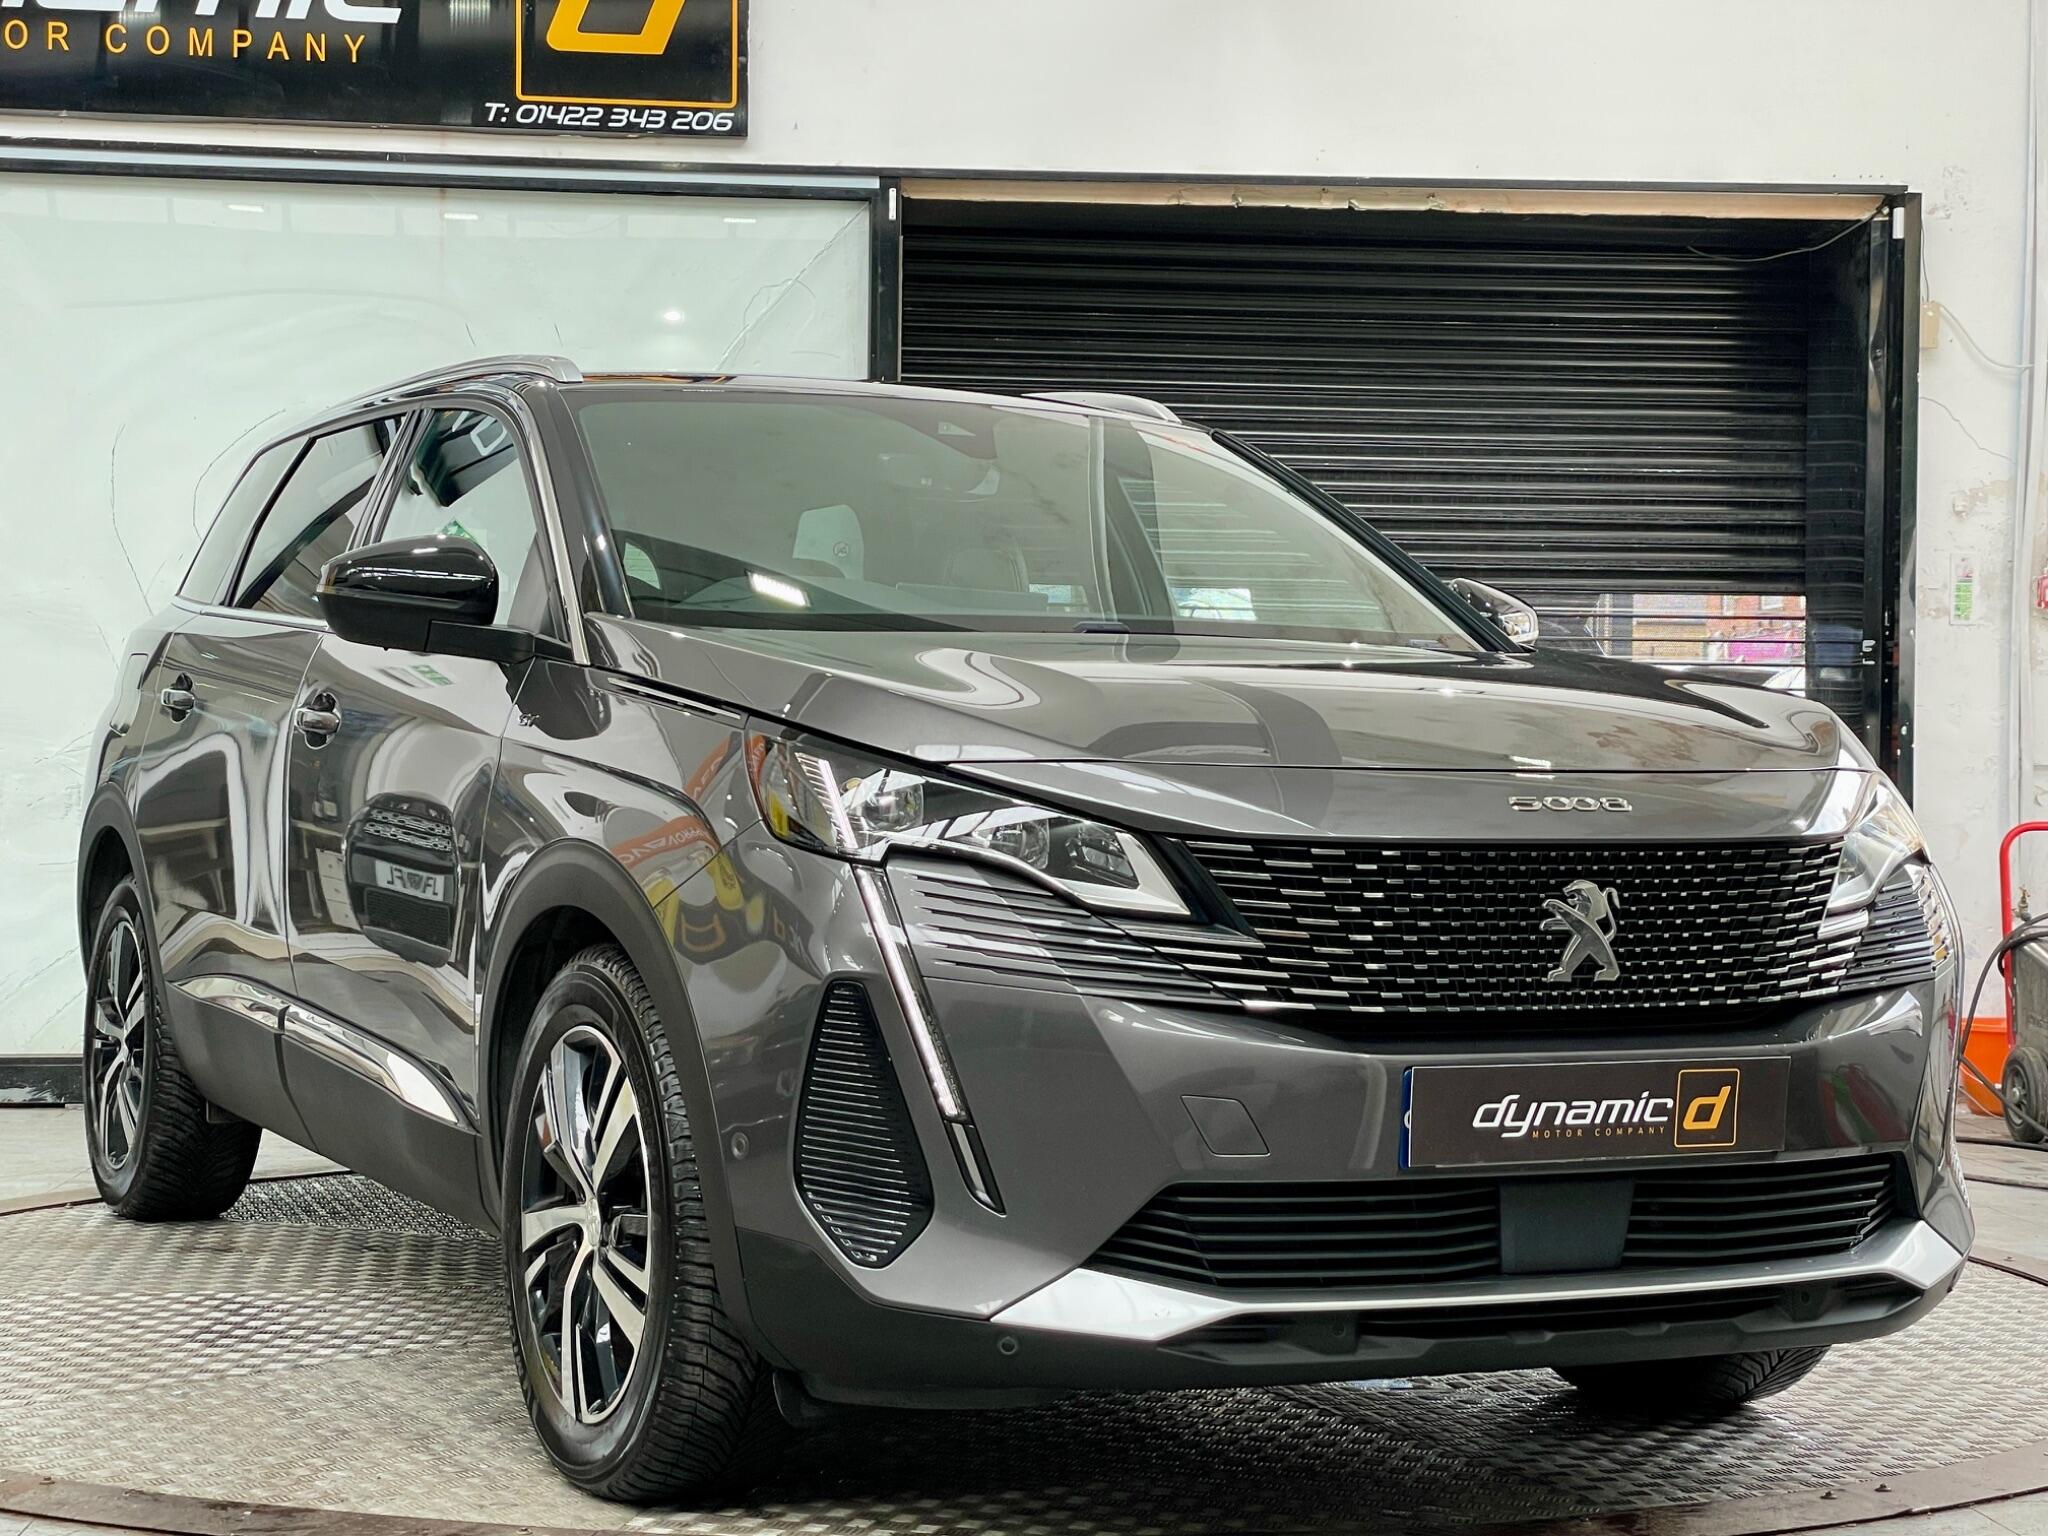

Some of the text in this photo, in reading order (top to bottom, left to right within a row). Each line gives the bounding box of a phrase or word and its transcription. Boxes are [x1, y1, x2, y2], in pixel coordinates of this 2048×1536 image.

[105, 24, 366, 63] COMPANY
[485, 102, 735, 131] T: 01422 343 206
[1508, 796, 1633, 812] 5008
[1472, 1085, 1732, 1138] dynamic d
[1532, 1125, 1667, 1139] MOTOR COMPANY
